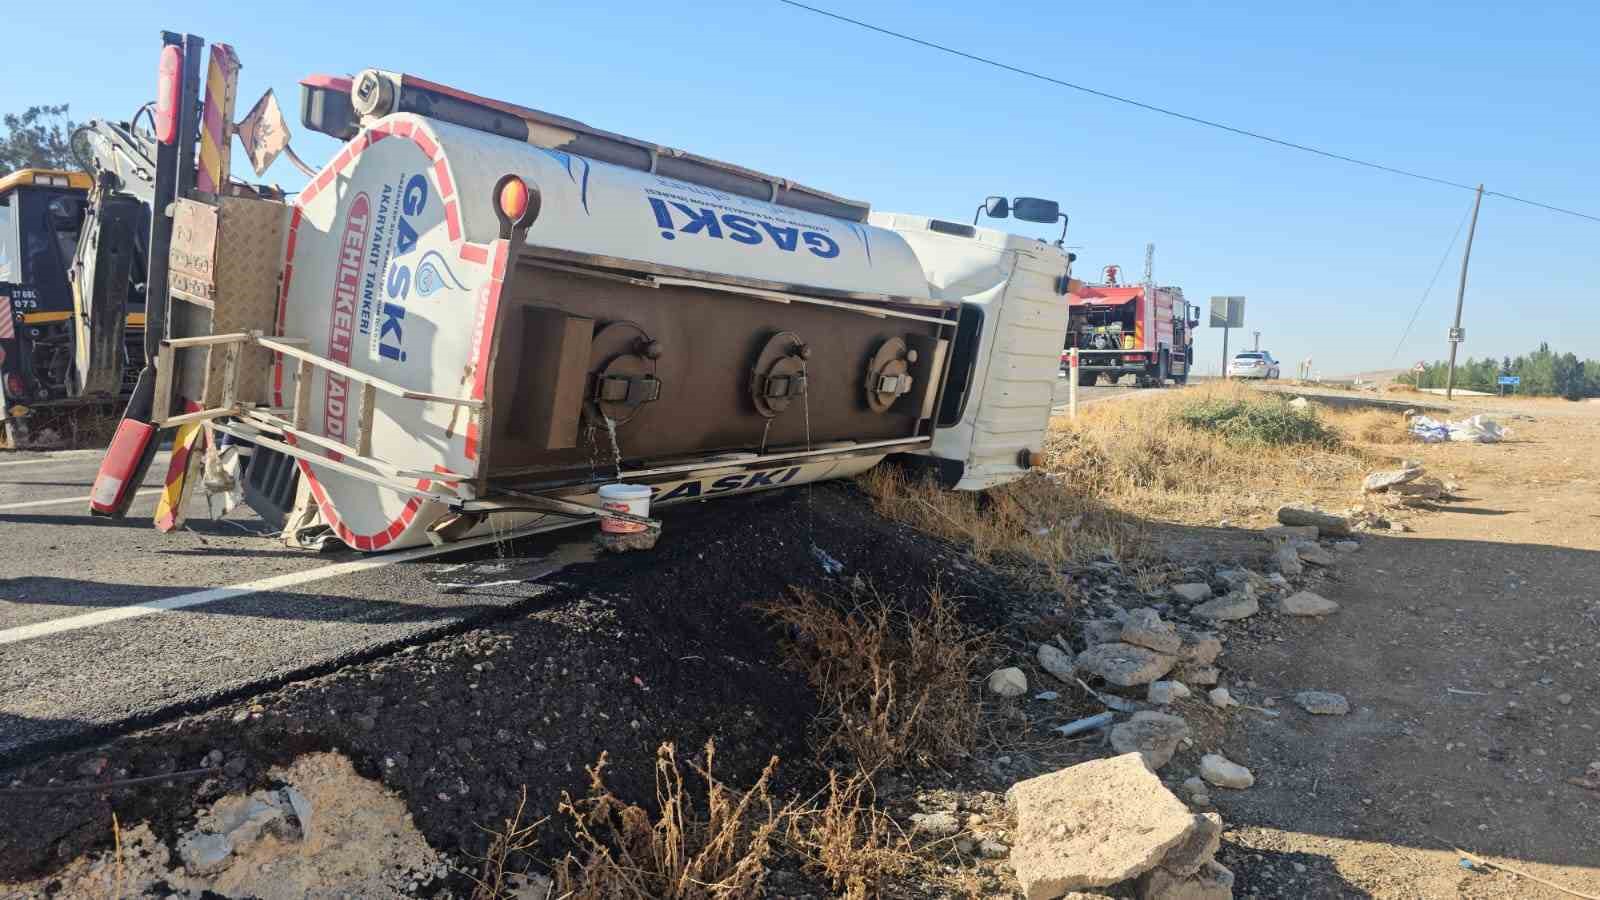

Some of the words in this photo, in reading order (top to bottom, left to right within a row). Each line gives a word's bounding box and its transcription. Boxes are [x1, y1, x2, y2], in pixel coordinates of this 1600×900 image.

[369, 184, 392, 266] AKARYAKIT
[648, 197, 840, 259] GASKİ
[332, 214, 368, 352] TEHLİKELİ
[360, 272, 376, 335] TANKERİ
[651, 467, 800, 501] ASKI
